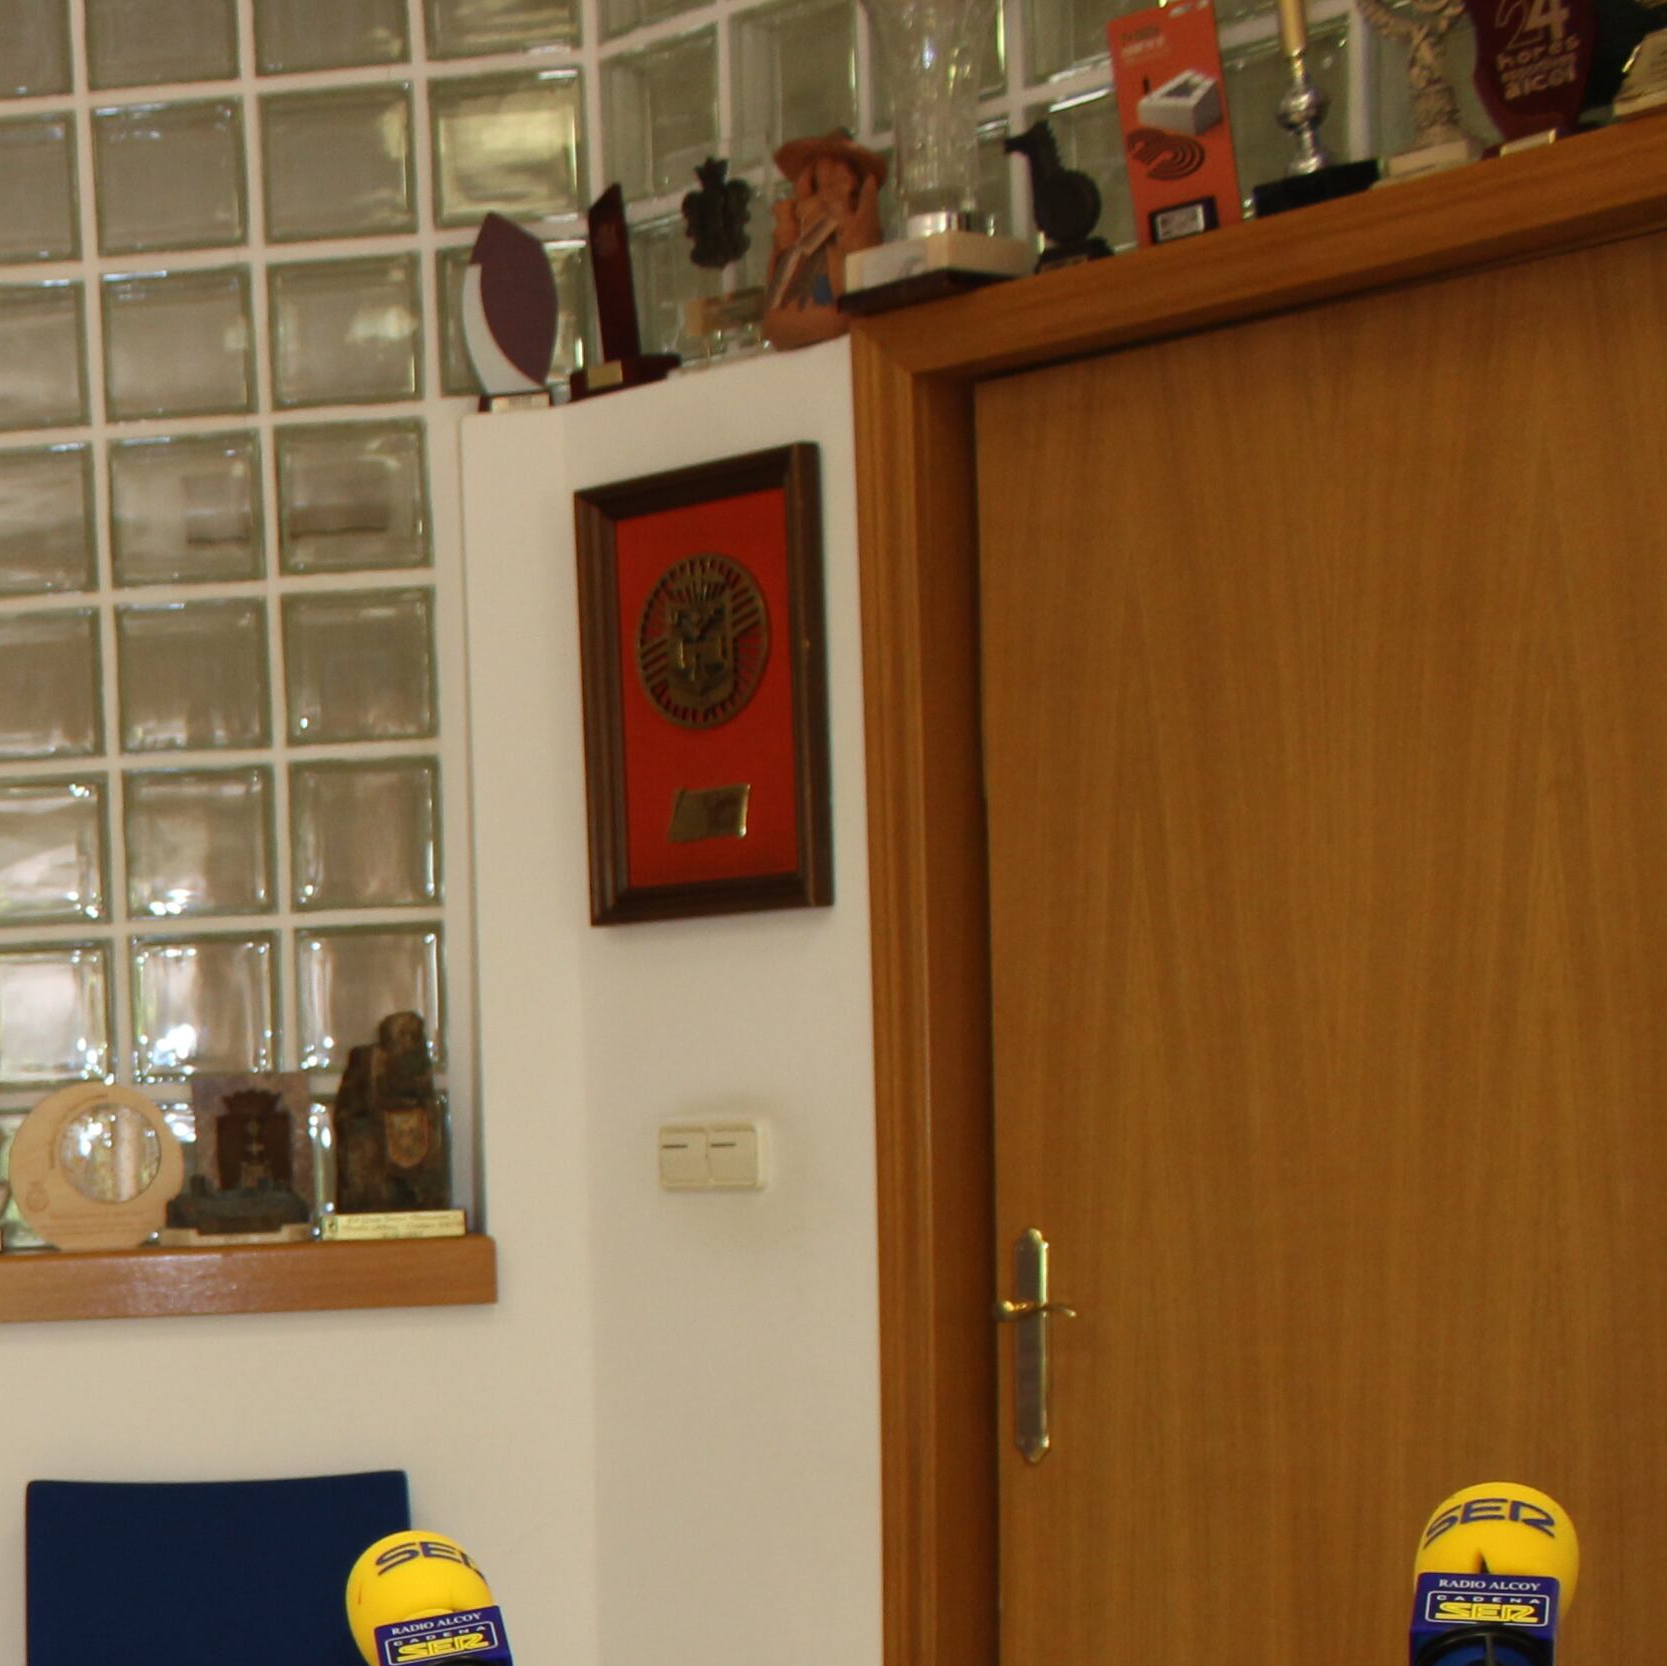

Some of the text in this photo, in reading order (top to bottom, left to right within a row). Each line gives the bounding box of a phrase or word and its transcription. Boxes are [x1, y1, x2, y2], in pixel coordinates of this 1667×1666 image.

[1423, 1497, 1557, 1551] SER
[1438, 1578, 1541, 1593] RADIO ALCOY
[391, 1612, 482, 1636] RADIO ALCOY
[1434, 1601, 1540, 1624] SER
[396, 1632, 489, 1662] SER
